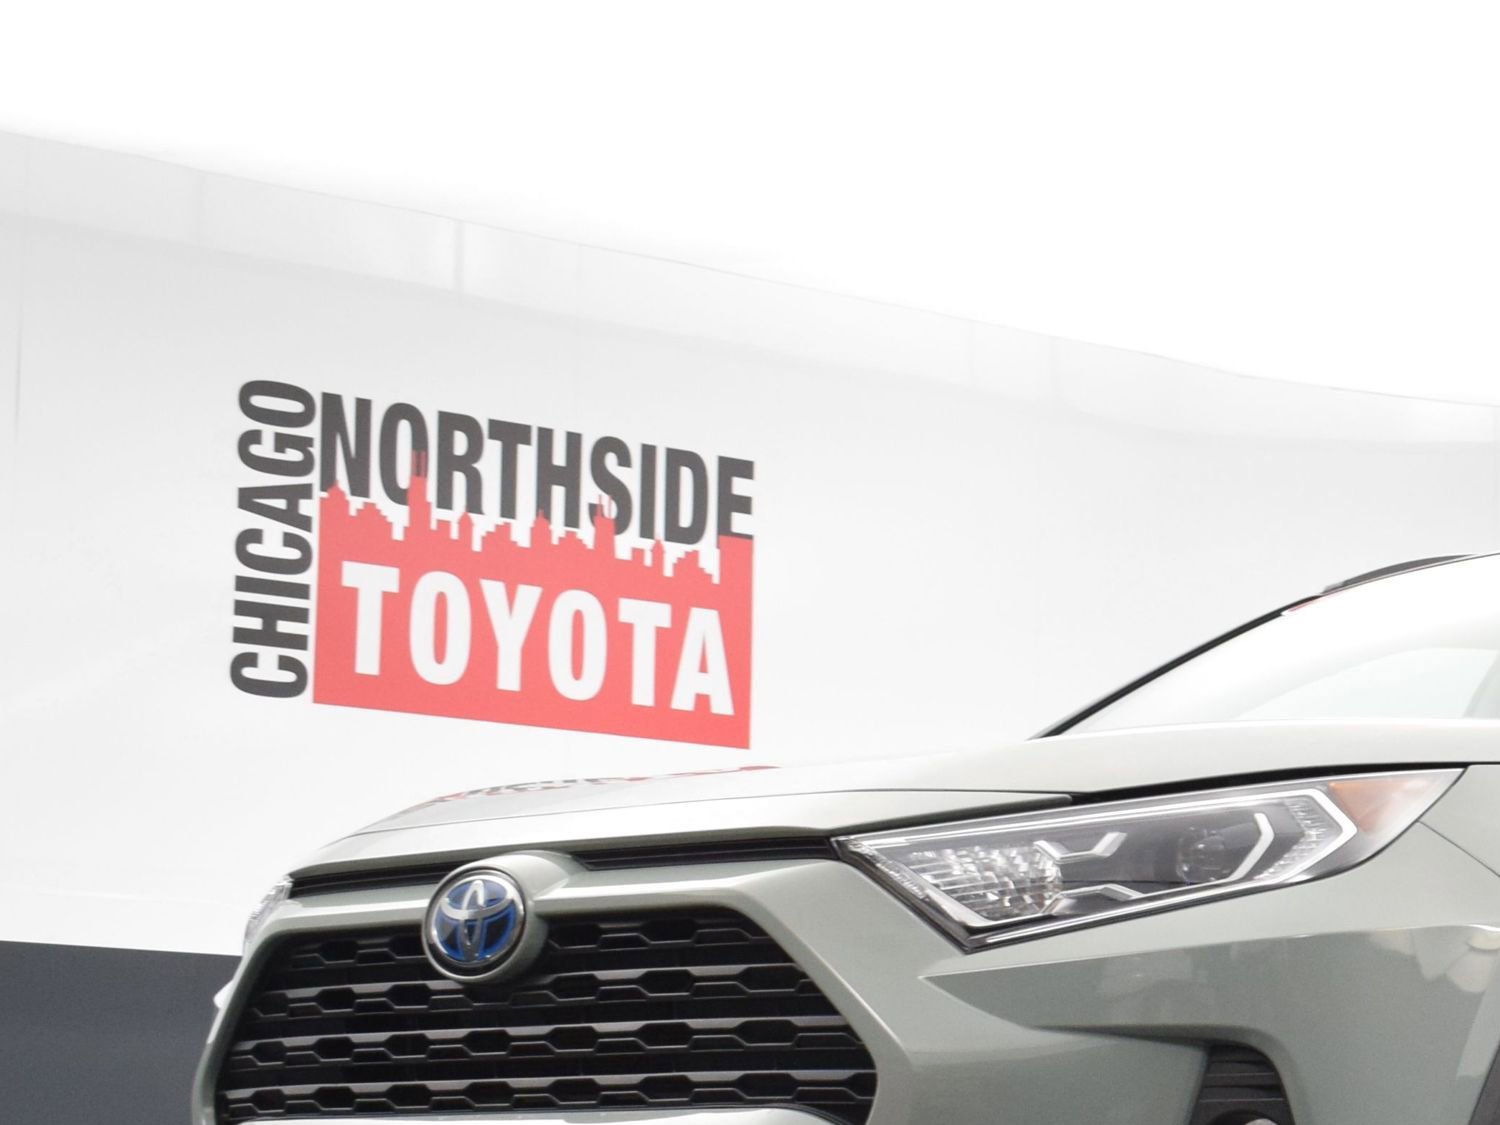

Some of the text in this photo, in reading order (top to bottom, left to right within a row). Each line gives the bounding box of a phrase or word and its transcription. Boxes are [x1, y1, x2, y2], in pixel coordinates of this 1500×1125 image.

[229, 379, 316, 699] CHICAGO
[319, 391, 755, 548] NORTHSIDE
[341, 560, 735, 716] TOYOTA
